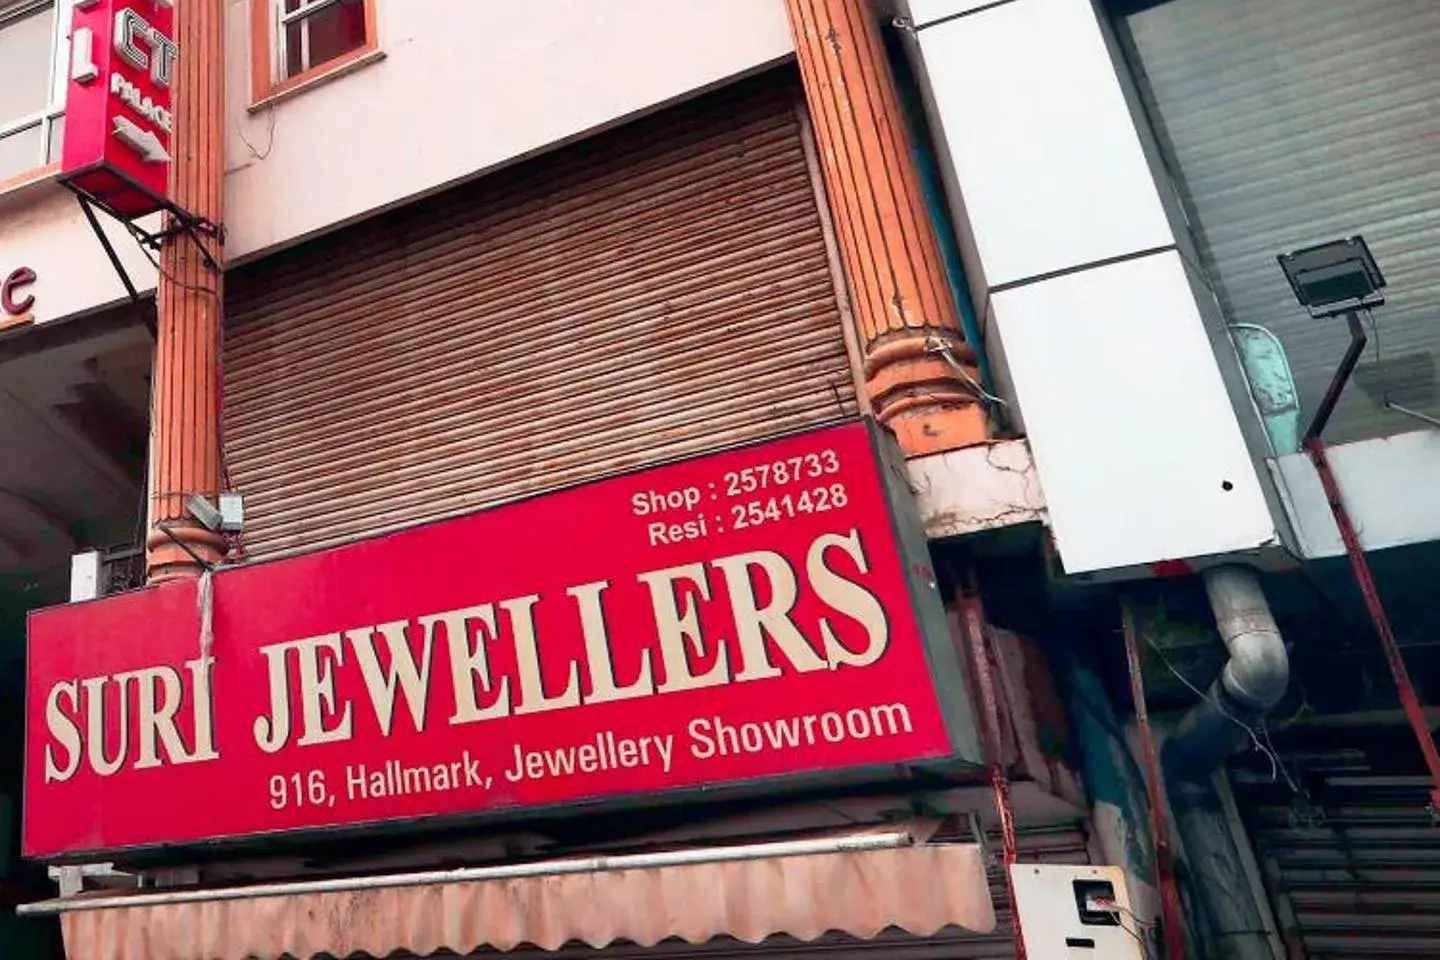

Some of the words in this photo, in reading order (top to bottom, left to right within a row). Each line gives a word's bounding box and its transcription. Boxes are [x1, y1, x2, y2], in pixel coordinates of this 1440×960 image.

[113, 11, 178, 88] CT
[631, 487, 700, 515] Shop
[724, 450, 840, 496] 2578733
[648, 514, 707, 546] Resi
[731, 483, 848, 530] 2541428
[45, 656, 220, 784] SURI
[253, 528, 889, 754] JEWELLERS
[269, 770, 335, 809] 916,
[347, 751, 494, 801] Hallmark,
[505, 731, 675, 783] Jewellery
[688, 701, 913, 760] Showroom
